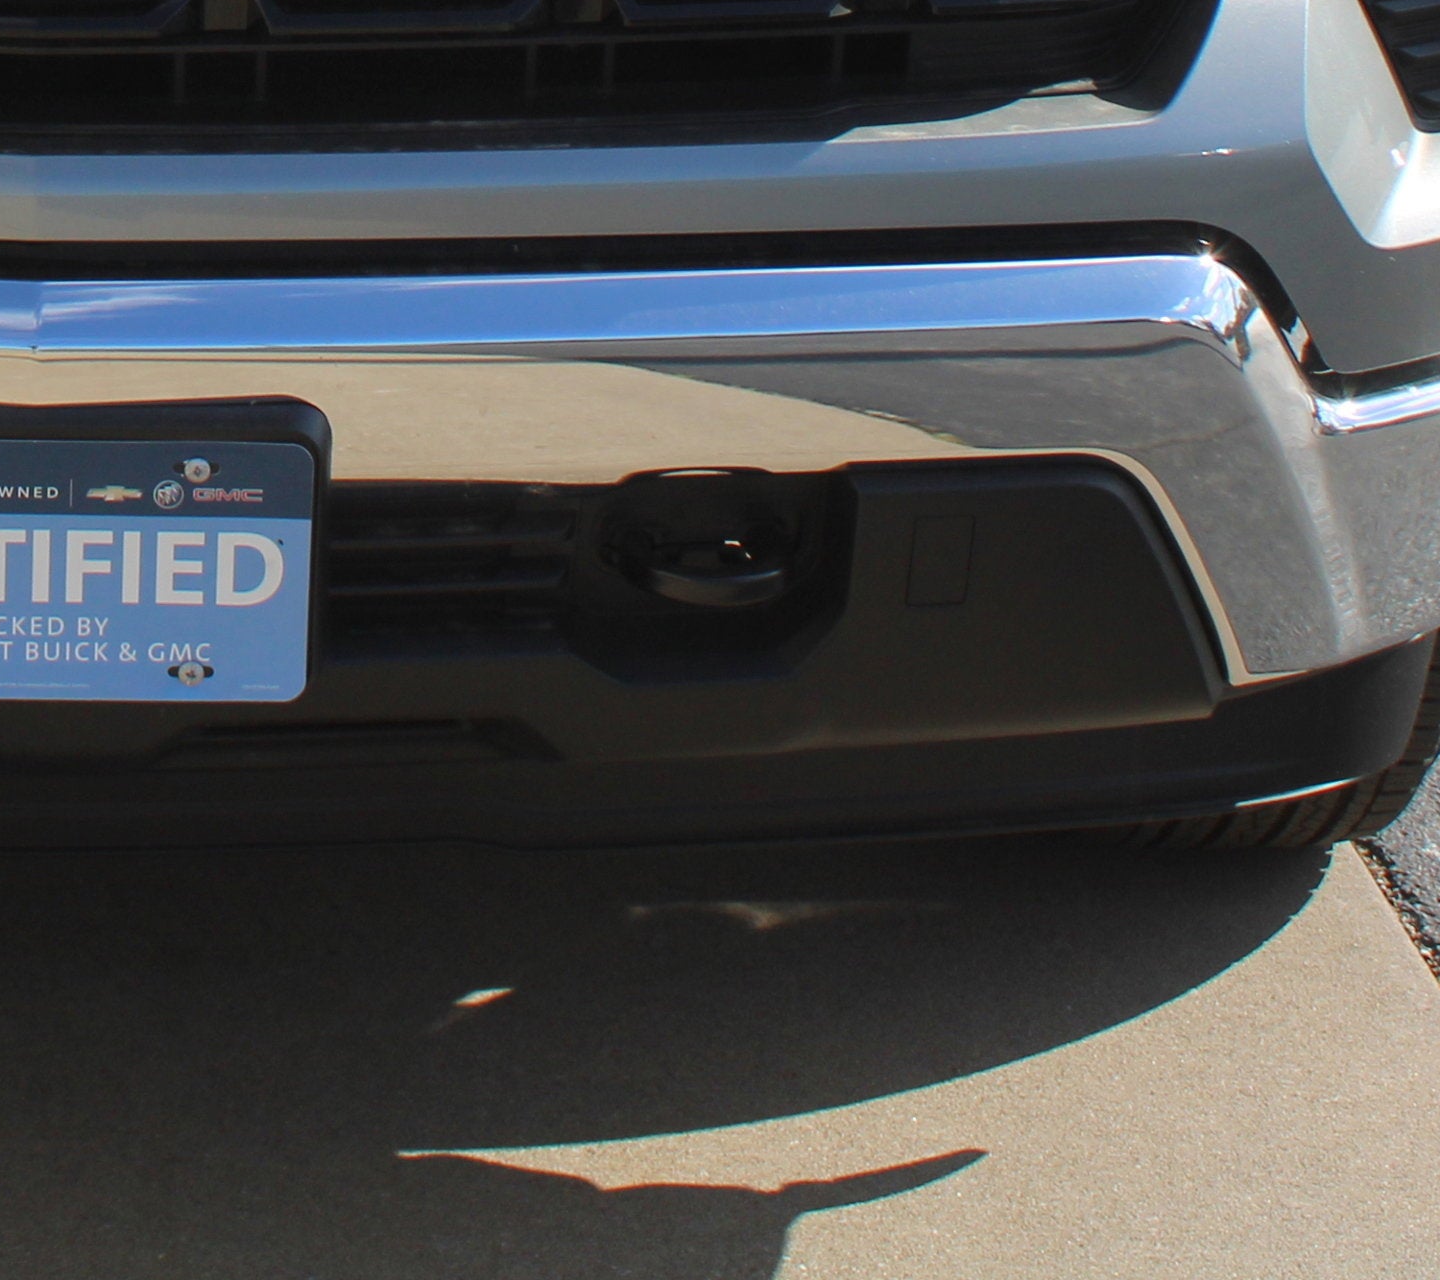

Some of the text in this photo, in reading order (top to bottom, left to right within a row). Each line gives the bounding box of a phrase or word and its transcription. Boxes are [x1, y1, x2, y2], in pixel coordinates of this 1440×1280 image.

[192, 487, 264, 503] GMC
[76, 616, 110, 638] BY
[25, 640, 109, 663] BUICK
[118, 642, 138, 664] &
[146, 642, 212, 664] GMC
